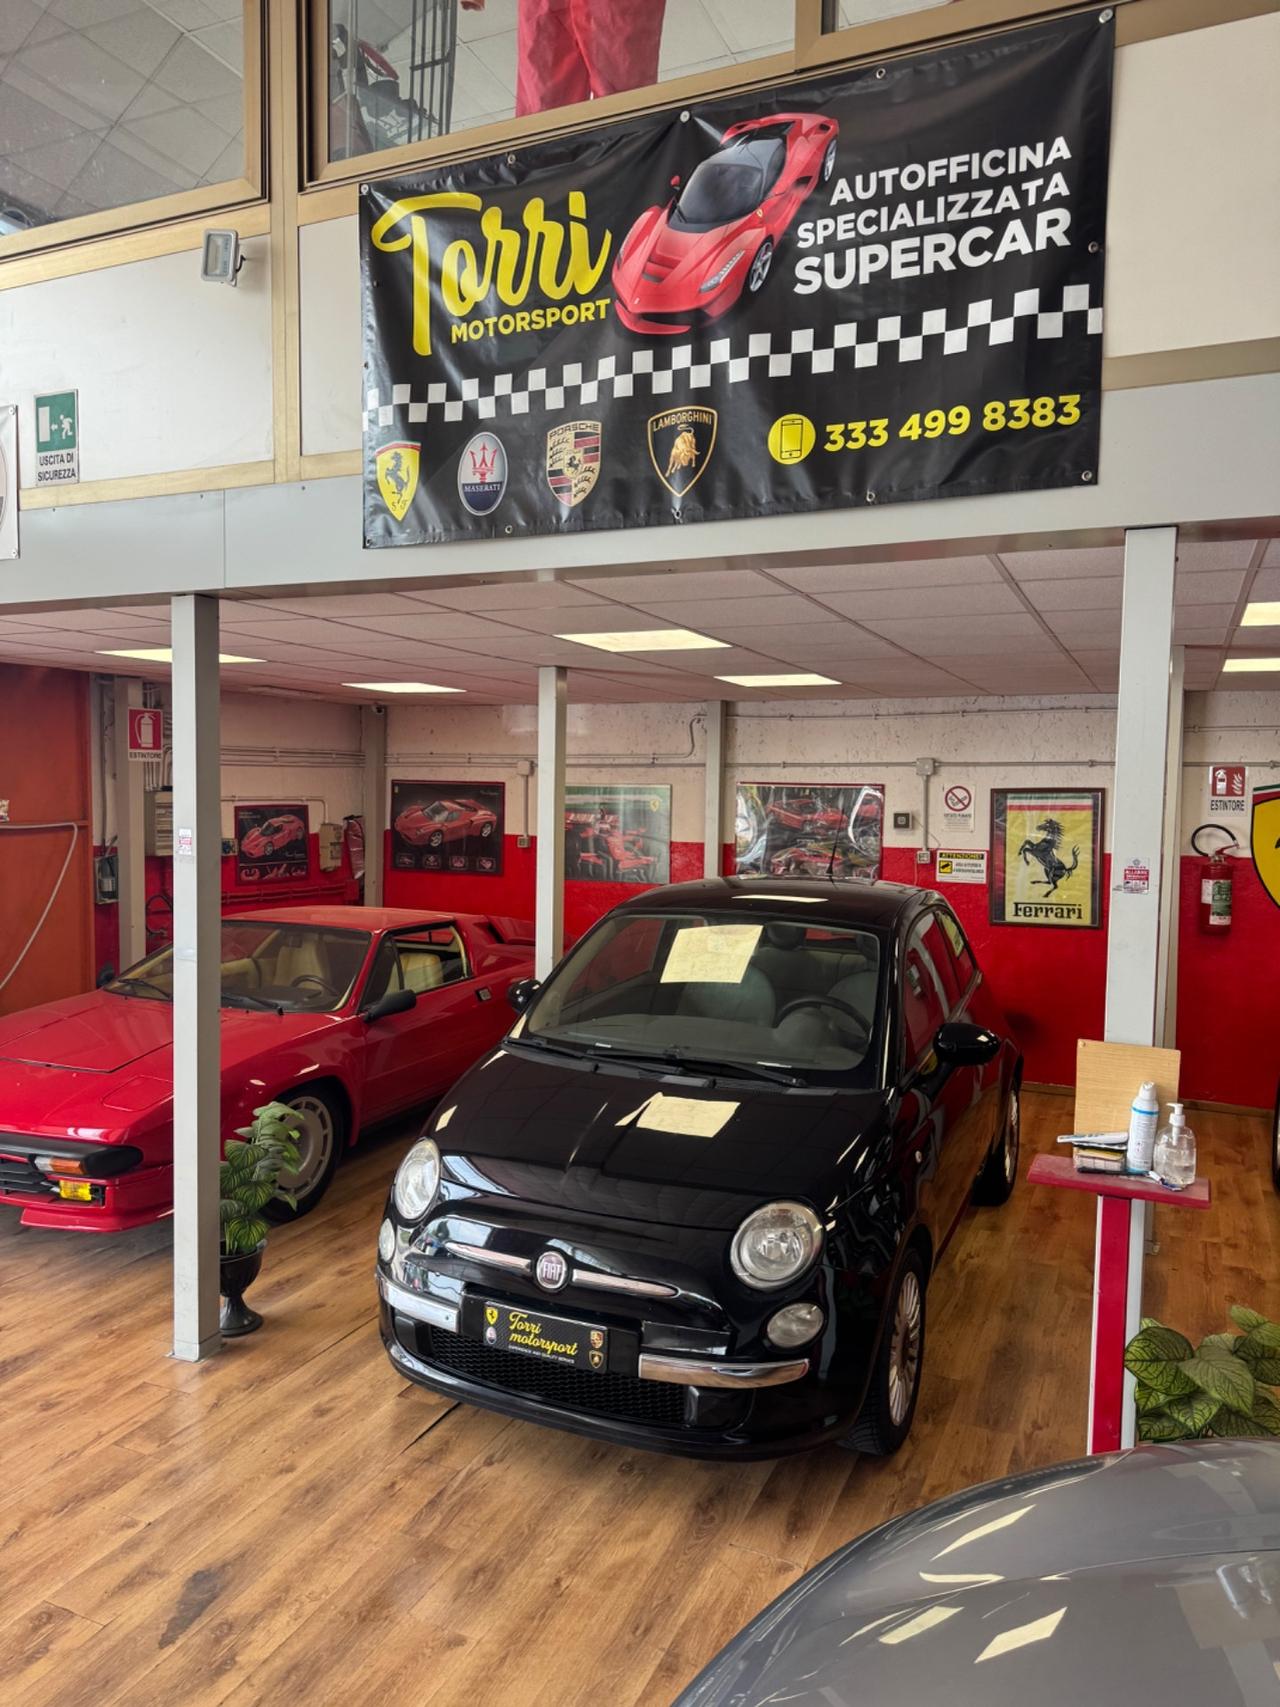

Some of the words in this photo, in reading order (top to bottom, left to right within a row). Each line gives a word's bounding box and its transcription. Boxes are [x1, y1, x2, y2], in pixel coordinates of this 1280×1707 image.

[829, 136, 1072, 206] AUTOFFICINA
[796, 171, 1071, 249] SPECIALIZZATA
[793, 207, 1072, 295] SUPERCAR
[371, 191, 612, 356] Torri
[451, 298, 611, 344] MOTORSPORT
[549, 422, 600, 437] PORSCHE
[652, 410, 712, 432] LAMBORGHINI
[823, 418, 889, 452] 333
[898, 405, 971, 441] 499
[982, 394, 1081, 432] 8383
[39, 453, 65, 466] USCITA
[66, 452, 74, 463] DI
[37, 468, 76, 482] SICUREZZA
[463, 483, 501, 493] MASERATI
[128, 751, 162, 759] ESTINTORE
[1210, 799, 1245, 812] ESTINTORE
[1013, 902, 1083, 920] Ferrari
[543, 1262, 562, 1281] FIAT
[508, 1311, 542, 1334] Torri
[508, 1332, 578, 1356] motorsport
